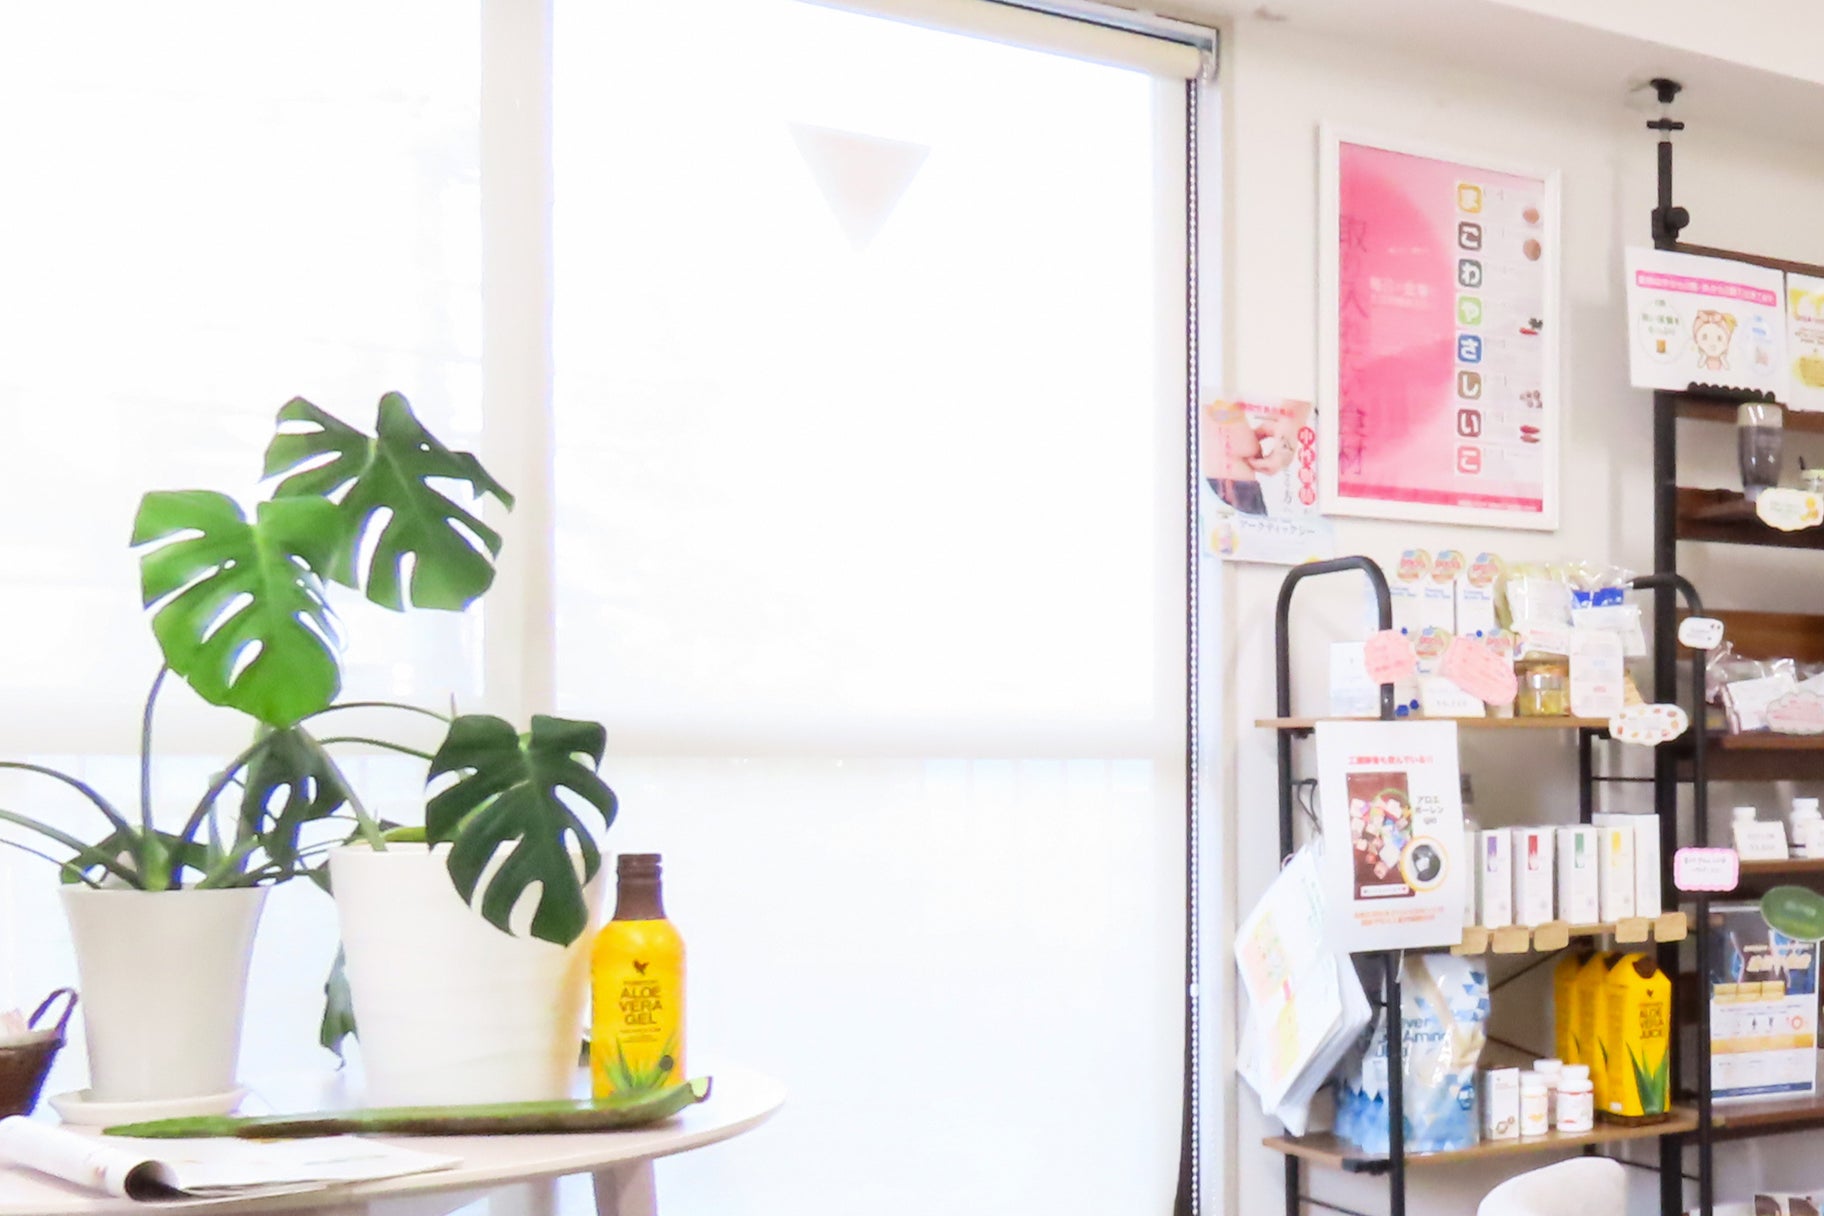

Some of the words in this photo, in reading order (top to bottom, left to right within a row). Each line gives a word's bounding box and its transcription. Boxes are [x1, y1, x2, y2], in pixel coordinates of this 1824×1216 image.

[620, 985, 661, 998] ALOE
[618, 1000, 663, 1012] VERA
[624, 1012, 657, 1025] GEL
